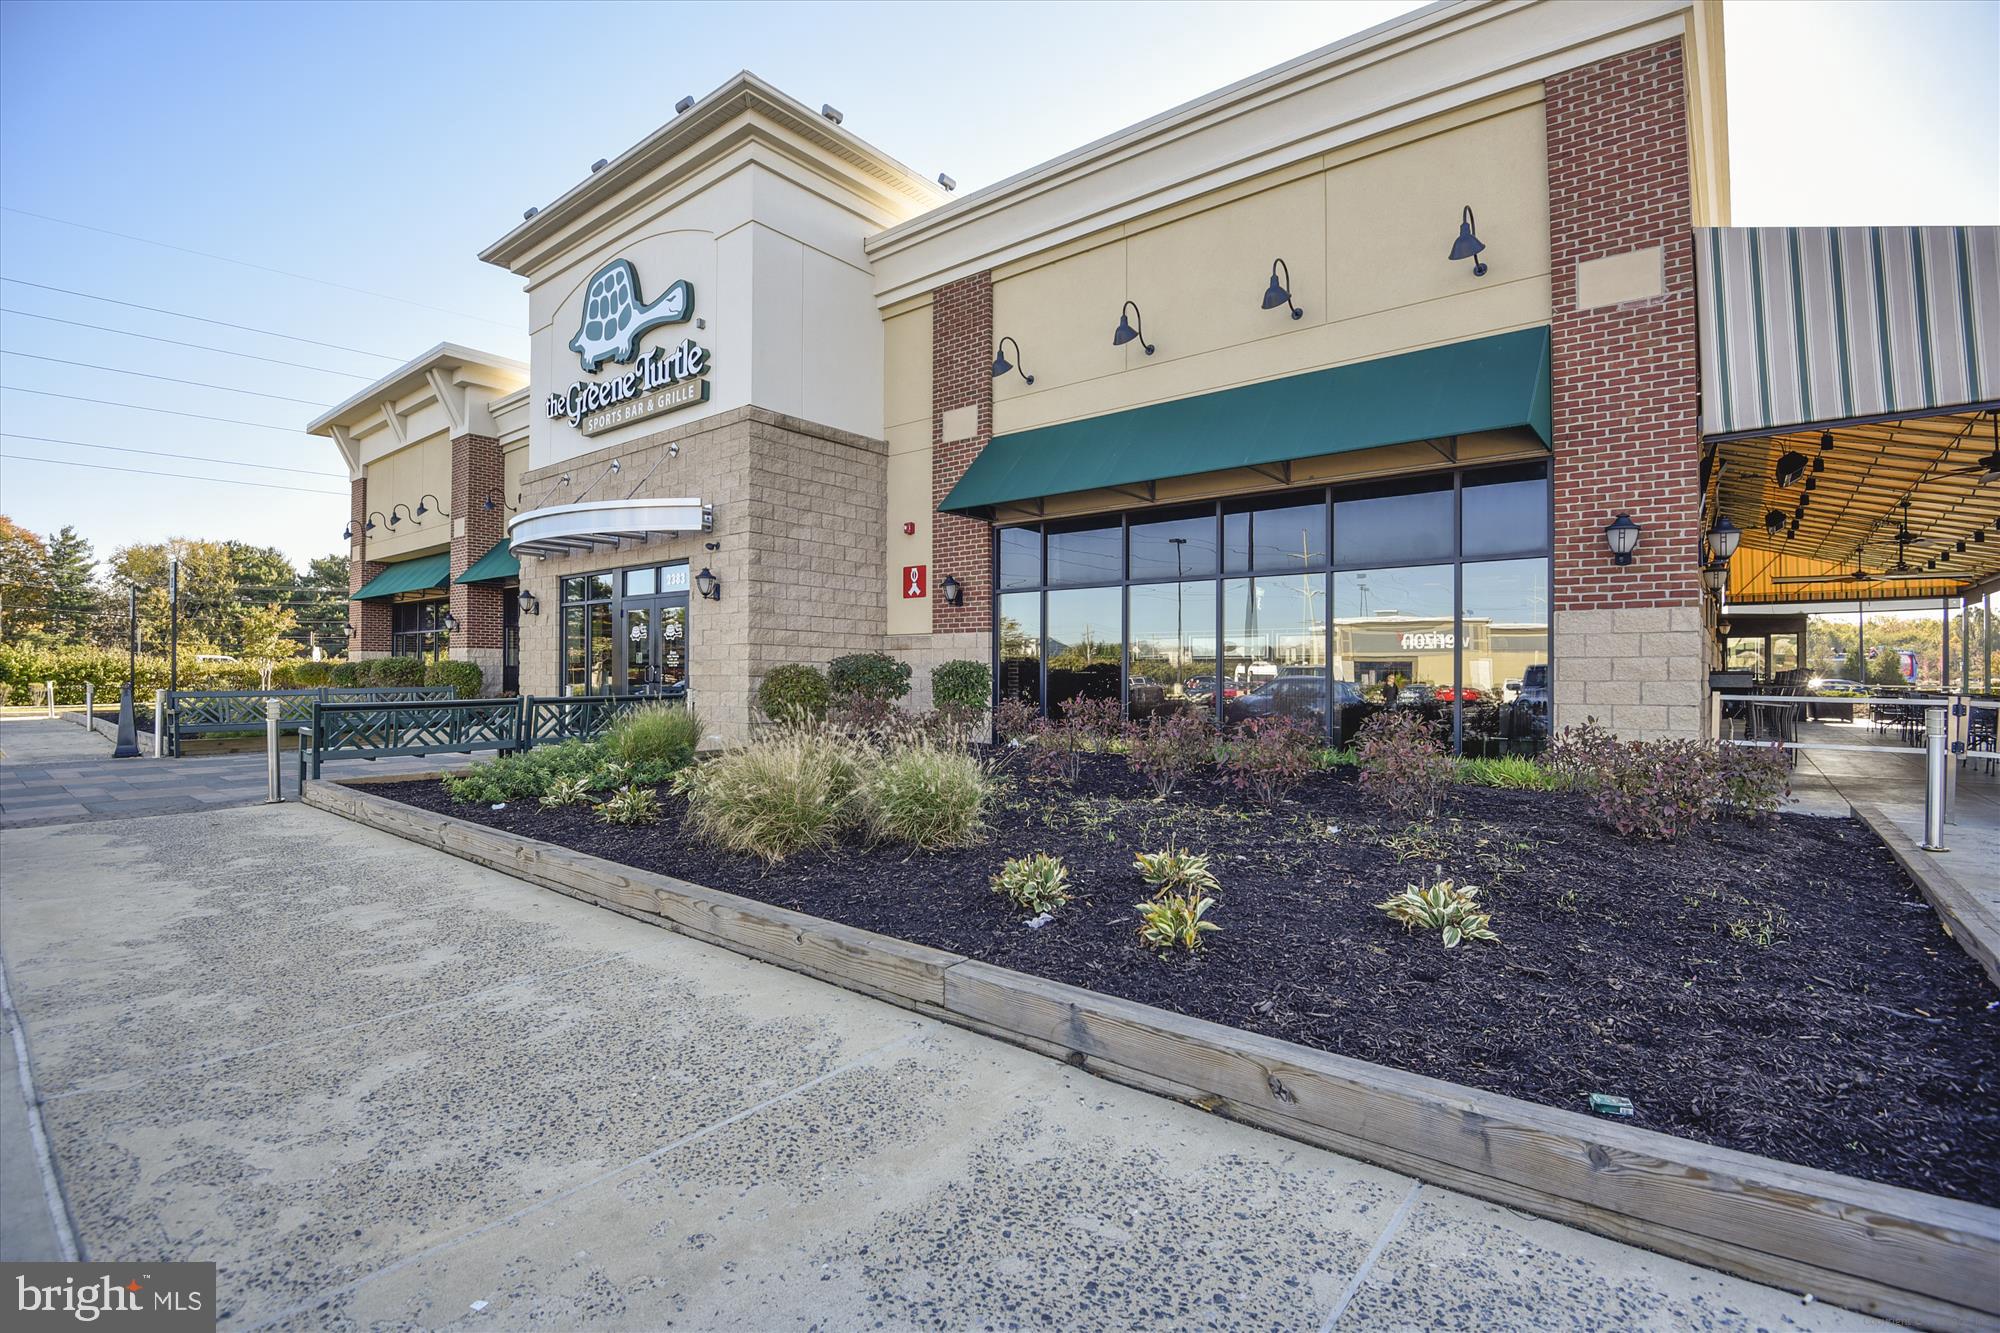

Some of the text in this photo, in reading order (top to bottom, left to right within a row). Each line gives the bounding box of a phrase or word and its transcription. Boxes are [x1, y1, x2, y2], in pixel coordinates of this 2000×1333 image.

[546, 338, 704, 428] the Greene Turtle
[588, 385, 694, 431] SPORTS BAR & GRILLE
